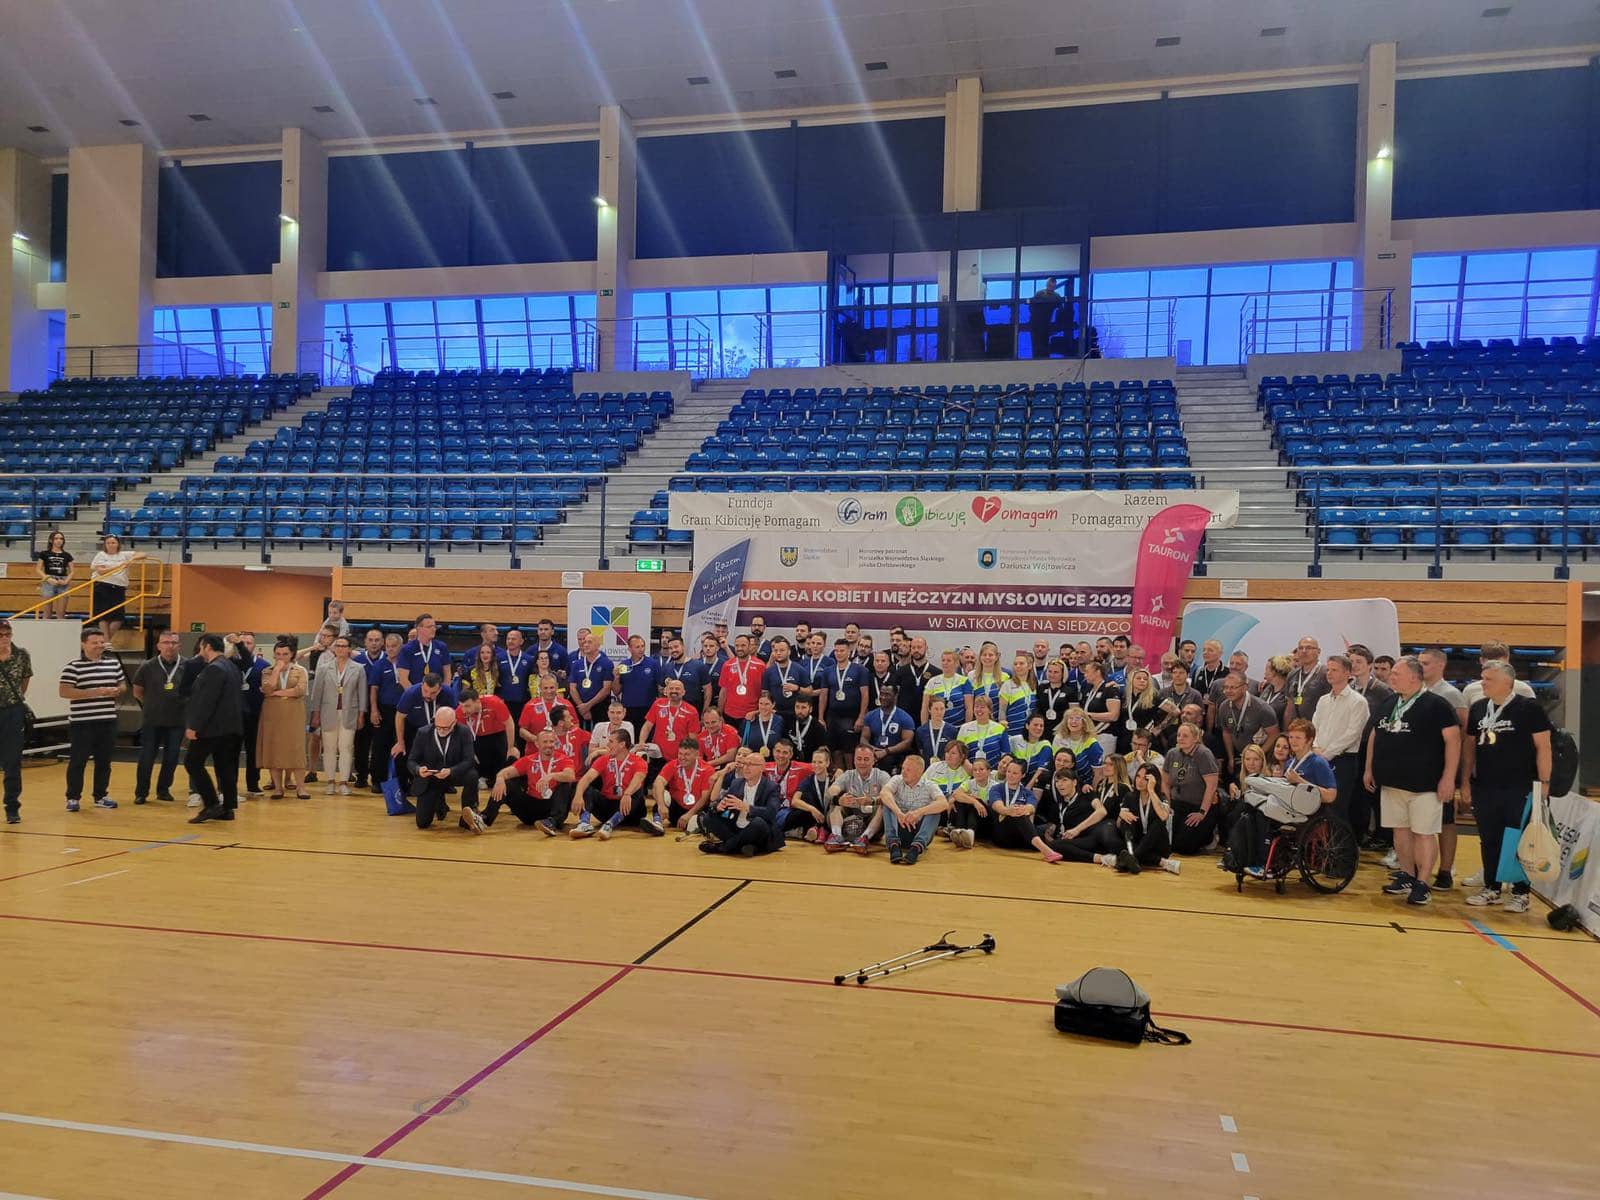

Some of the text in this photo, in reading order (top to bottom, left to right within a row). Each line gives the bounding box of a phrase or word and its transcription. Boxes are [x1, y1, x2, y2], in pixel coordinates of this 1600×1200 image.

[728, 497, 773, 510] Fundcja
[1124, 494, 1168, 506] Razem
[681, 514, 820, 529] Gram Kibicuję Pomagam
[1071, 513, 1143, 527] Pomagamy
[1148, 543, 1190, 563] TAURON
[715, 558, 741, 573] Razem
[739, 588, 1132, 607] UROLIGA KOBIET I MĘŻCZYZN MYSŁOWICE 2022
[928, 616, 1132, 635] W SIATKÓWCE NA SIEDZĄCO
